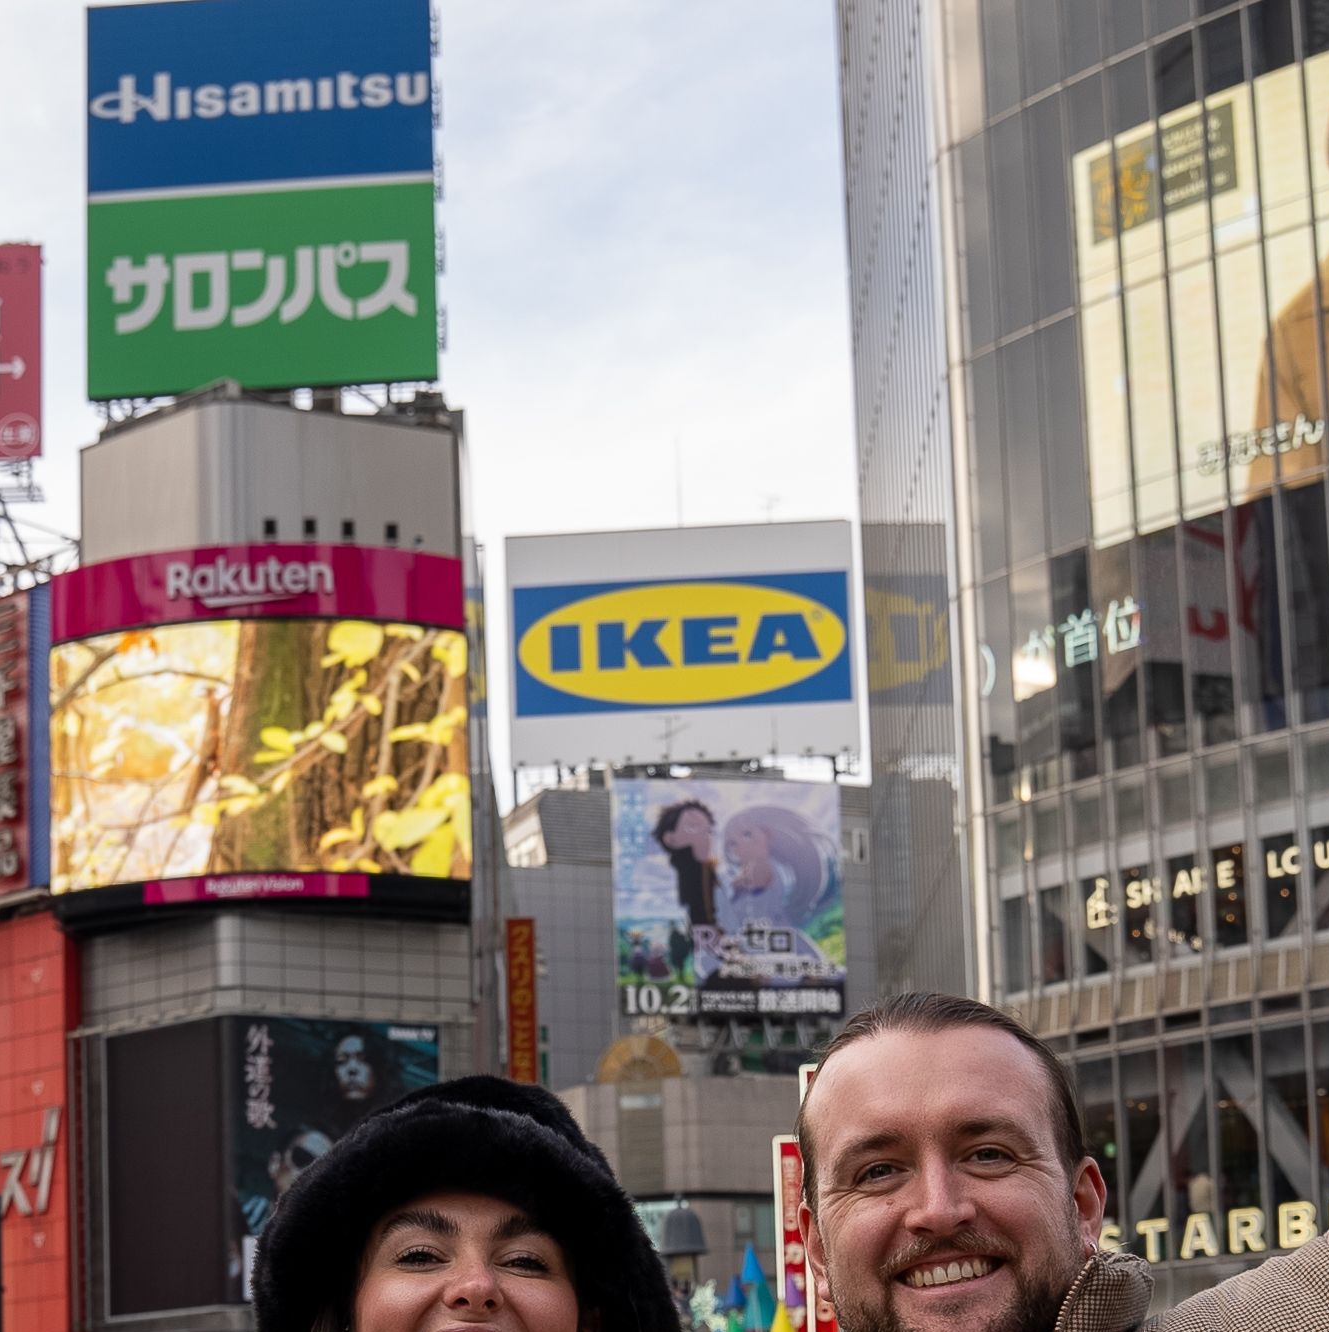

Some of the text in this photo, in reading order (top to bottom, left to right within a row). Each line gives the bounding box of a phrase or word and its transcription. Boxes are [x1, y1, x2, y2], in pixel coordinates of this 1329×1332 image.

[89, 71, 429, 124] Hisamitsu
[106, 240, 418, 336] サロンパス
[165, 557, 335, 604] Rakuten
[549, 612, 824, 673] IKEA
[625, 985, 689, 1015] 10.2
